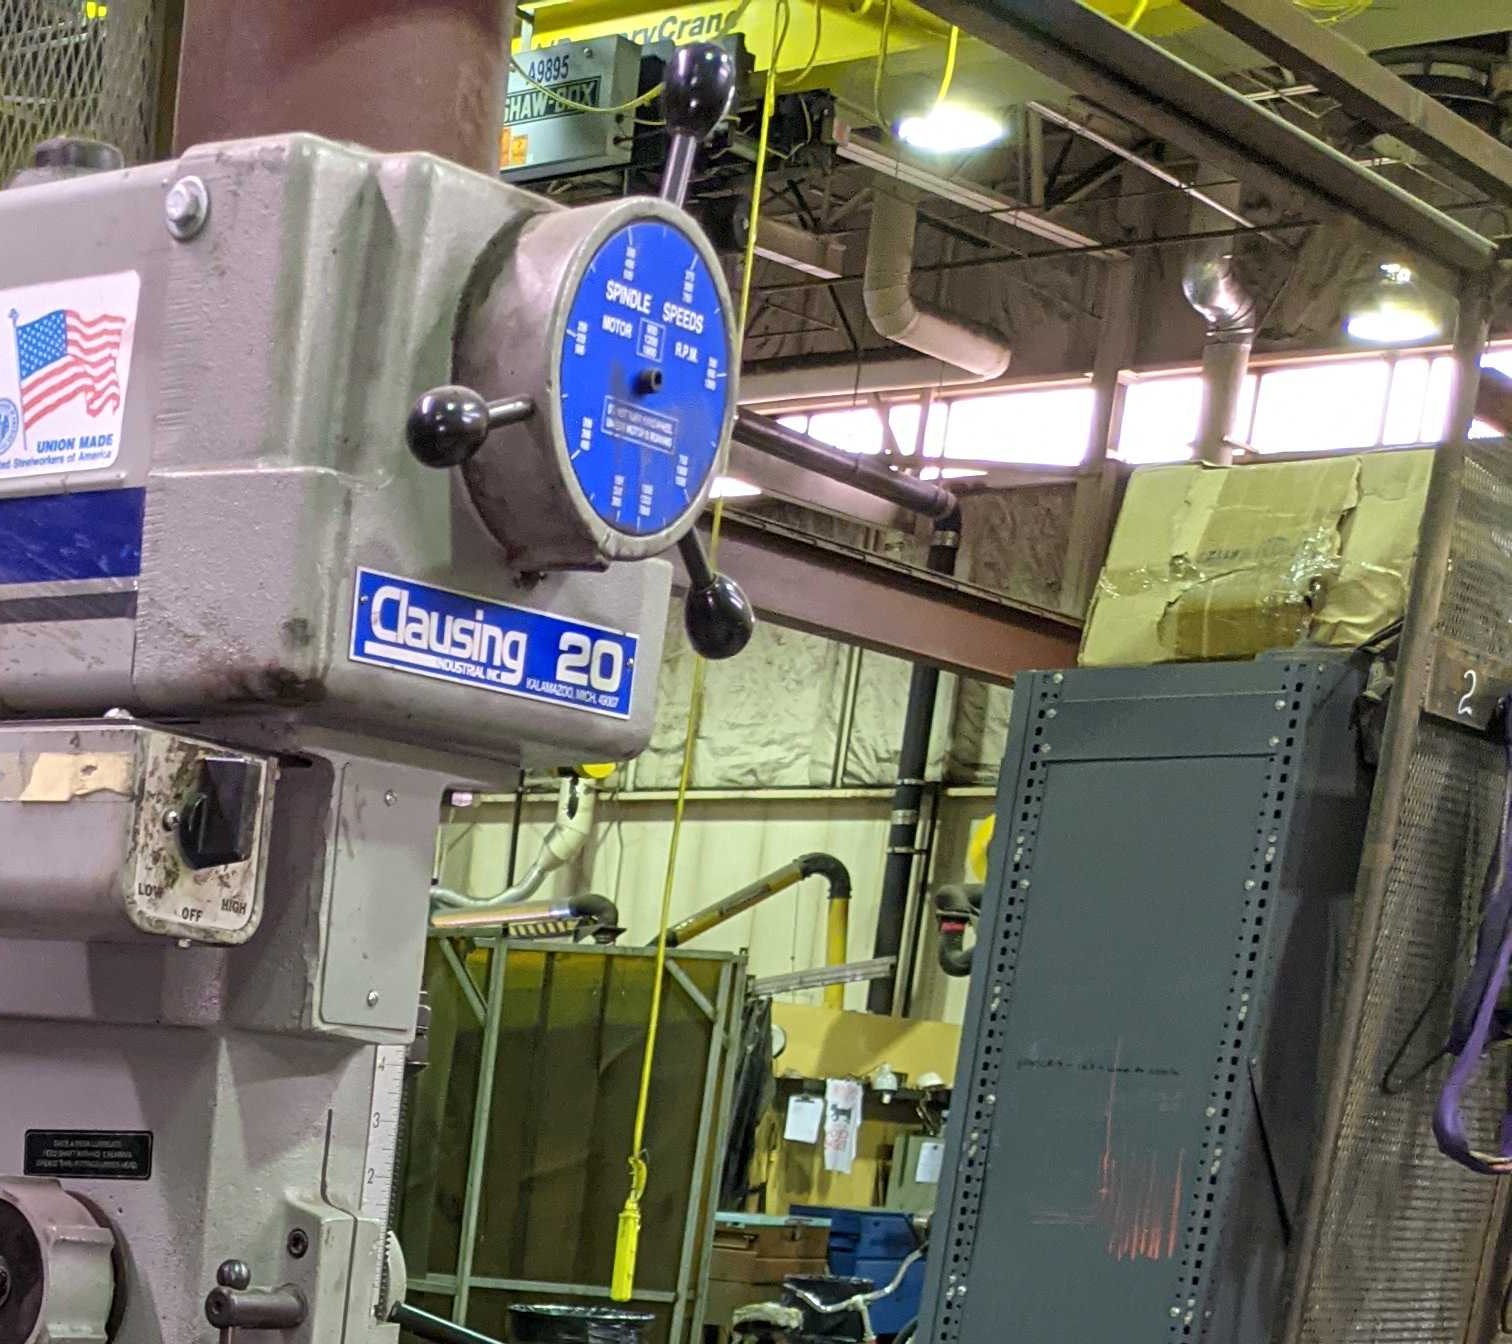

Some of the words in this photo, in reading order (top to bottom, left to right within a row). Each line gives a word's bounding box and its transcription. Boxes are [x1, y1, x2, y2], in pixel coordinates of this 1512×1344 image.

[528, 55, 570, 83] A9895
[606, 280, 652, 315] SPINDLE
[663, 302, 704, 334] SPEEDS
[601, 314, 633, 339] MOTOR
[37, 438, 75, 453] UNION
[78, 434, 114, 449] MADE
[13, 455, 65, 469] Steelworkers
[67, 453, 76, 463] of
[78, 451, 112, 462] America
[371, 585, 528, 685] Clausing
[556, 632, 624, 692] 20
[138, 882, 164, 898] LOW
[181, 907, 203, 922] OFF
[221, 898, 247, 915] HIGH
[372, 1112, 381, 1129] 3
[367, 1168, 375, 1184] 2
